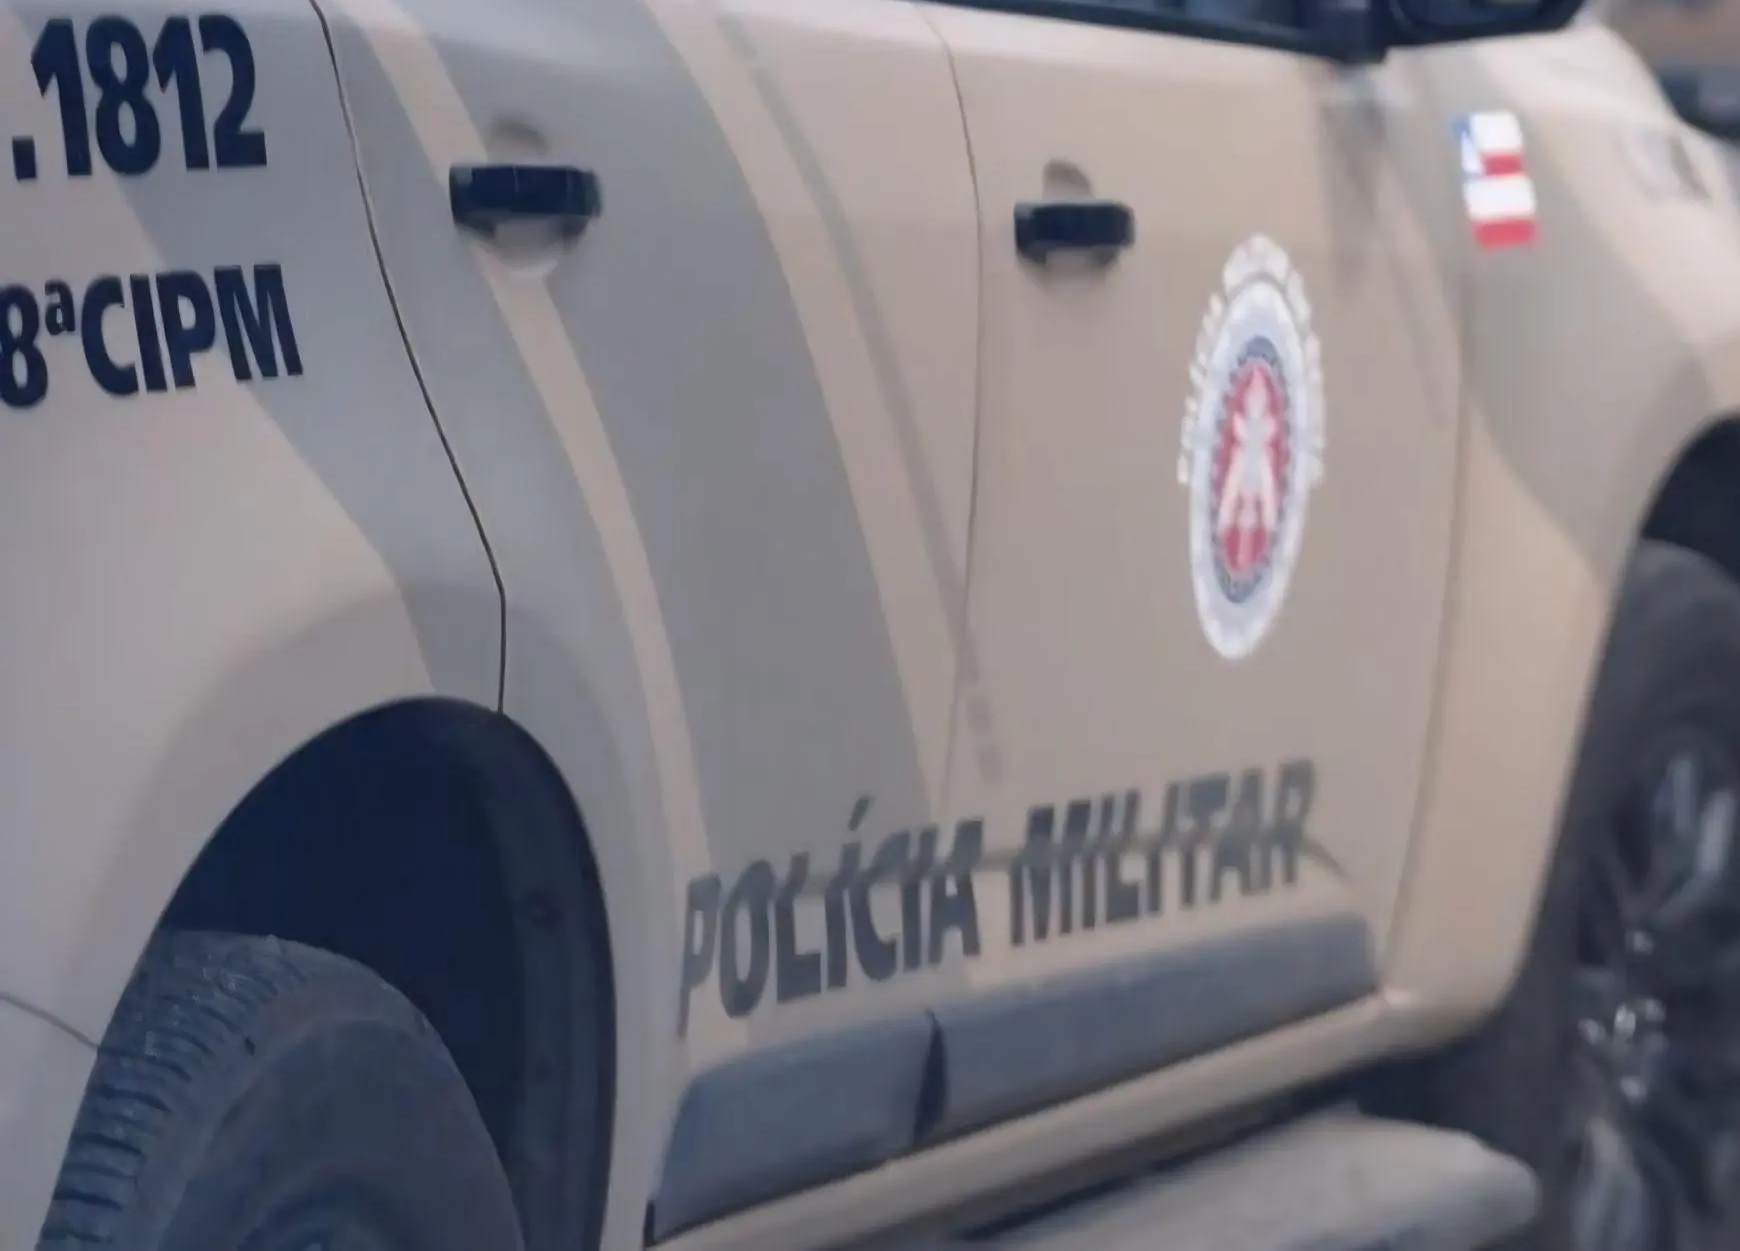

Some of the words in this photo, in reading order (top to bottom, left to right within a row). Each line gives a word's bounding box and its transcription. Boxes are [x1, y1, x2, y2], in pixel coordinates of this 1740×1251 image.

[11, 13, 268, 181] .1812
[676, 795, 985, 1042] POLÍCIA
[1008, 757, 1318, 948] MILITAR
